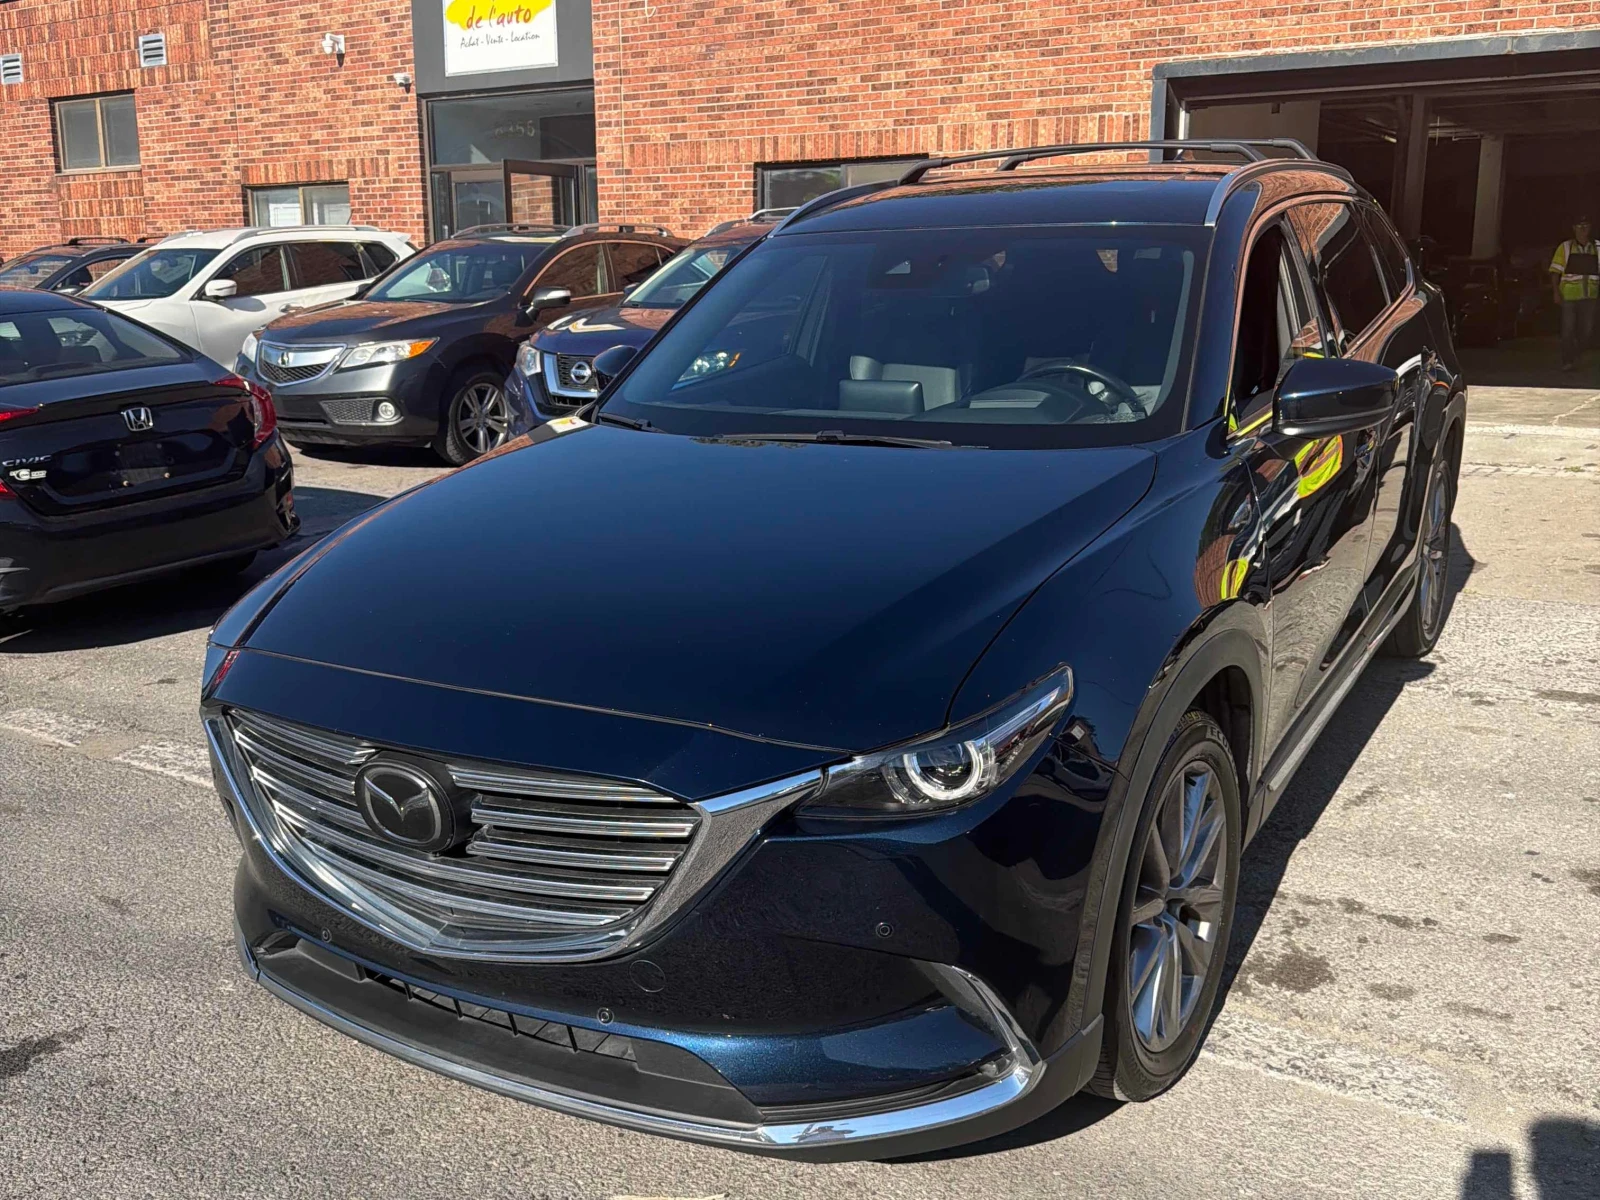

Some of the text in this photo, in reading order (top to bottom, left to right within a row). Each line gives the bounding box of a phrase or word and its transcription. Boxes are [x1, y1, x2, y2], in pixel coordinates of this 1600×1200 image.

[466, 4, 532, 31] de l'auto
[460, 37, 480, 49] Achat
[485, 33, 504, 46] Vente
[511, 30, 541, 43] Location
[2, 454, 52, 467] CIVIC
